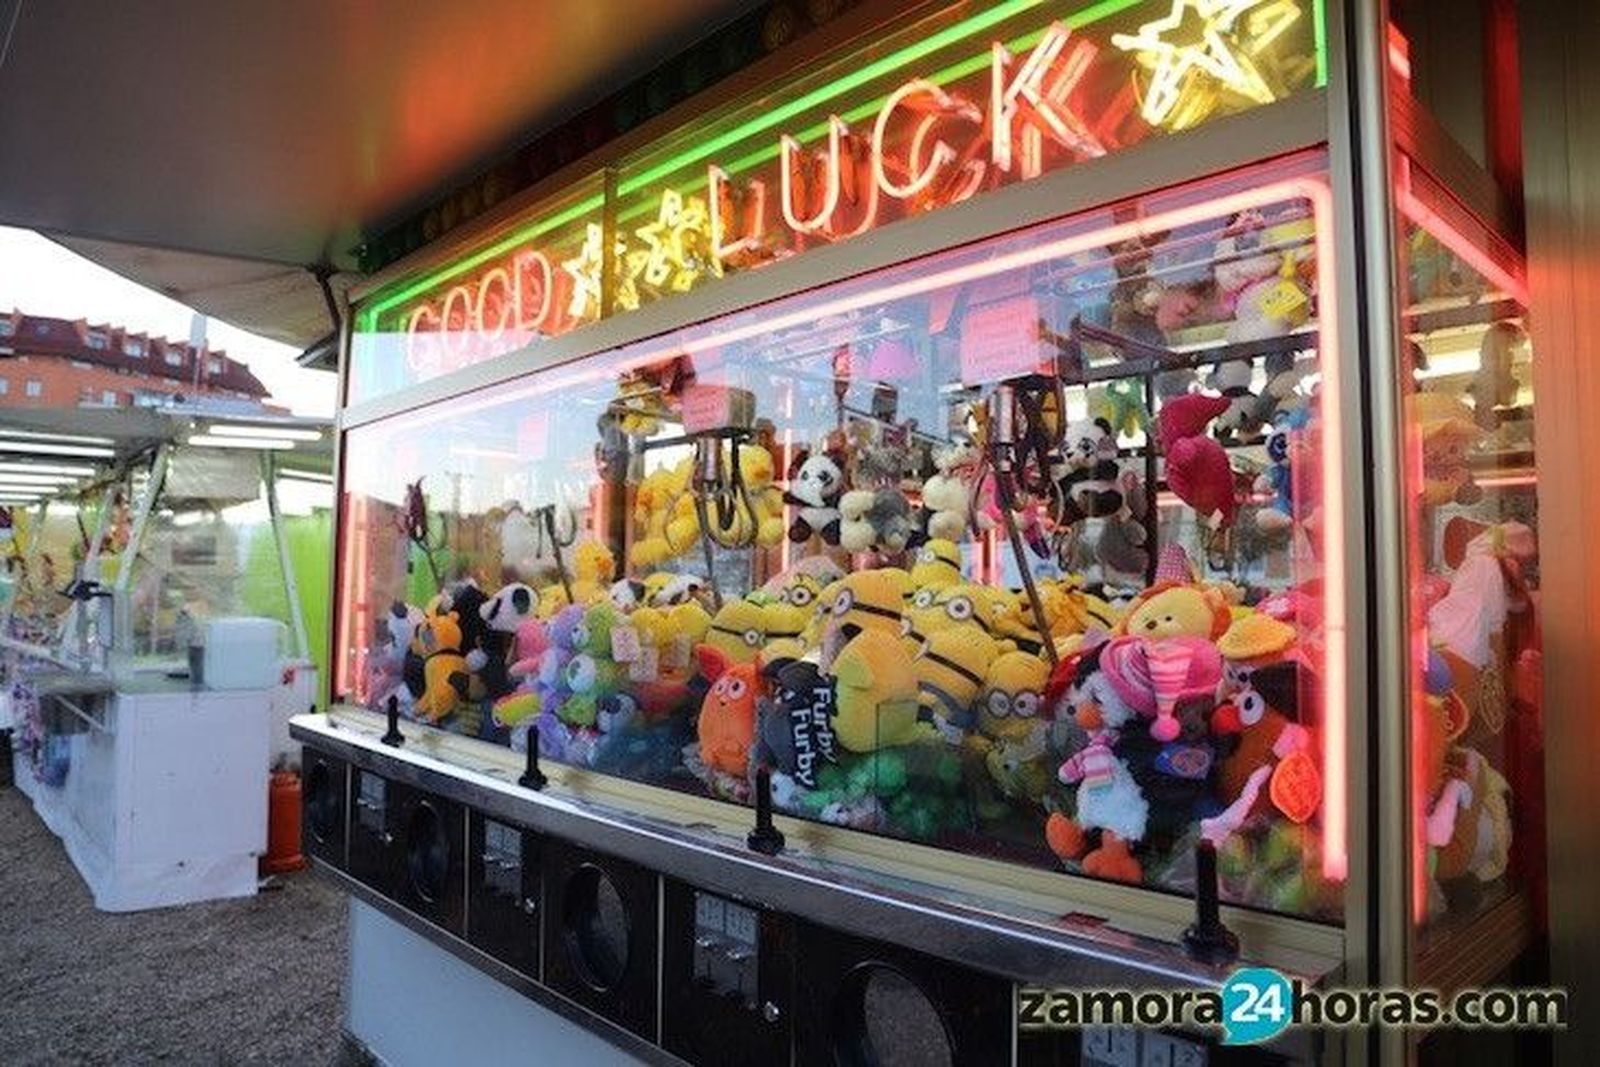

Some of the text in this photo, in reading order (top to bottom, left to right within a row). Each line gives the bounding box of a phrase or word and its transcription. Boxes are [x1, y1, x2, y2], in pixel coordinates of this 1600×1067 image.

[406, 20, 1108, 372] GOOD LUCK
[792, 708, 816, 787] Furby
[813, 687, 837, 764] Furby
